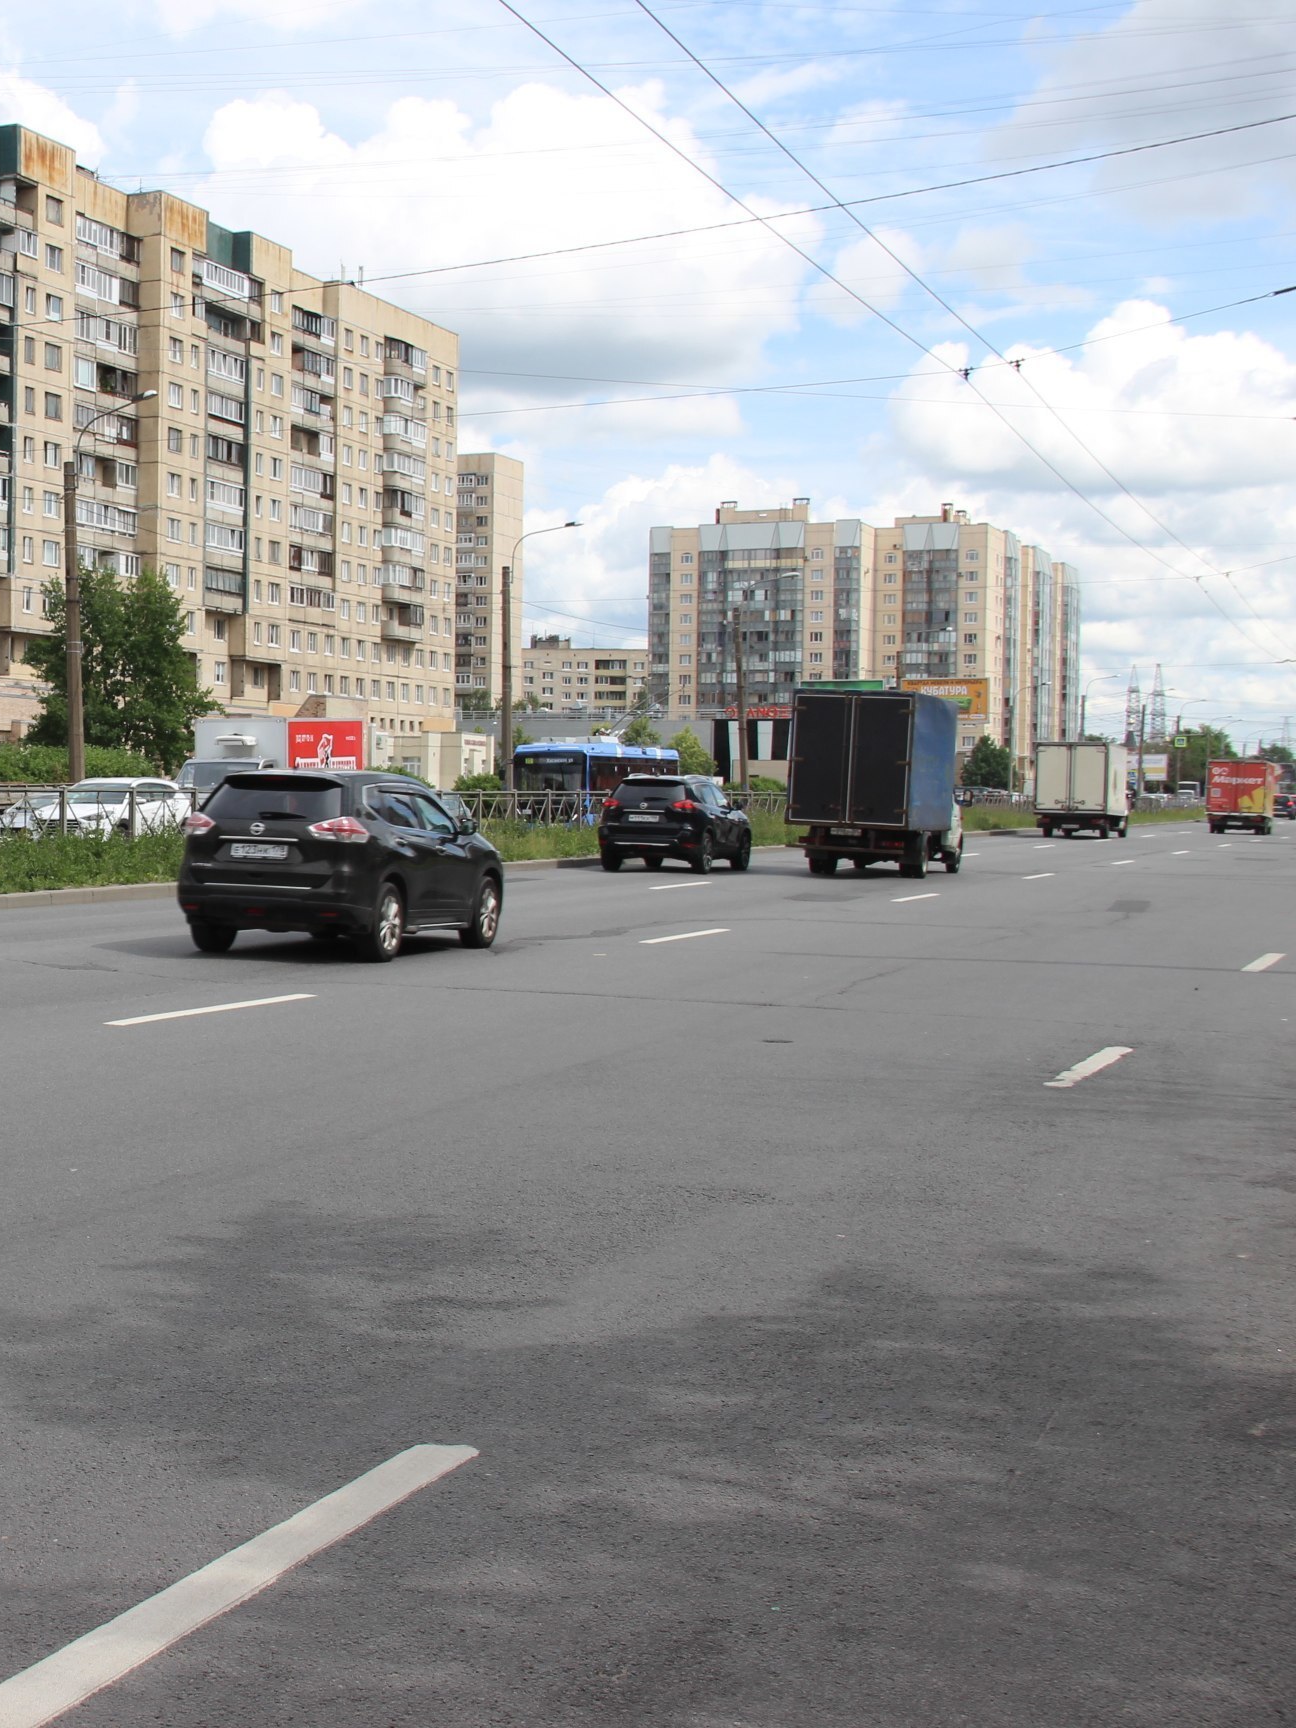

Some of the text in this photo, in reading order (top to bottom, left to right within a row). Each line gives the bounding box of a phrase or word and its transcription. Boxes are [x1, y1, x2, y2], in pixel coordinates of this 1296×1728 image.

[920, 685, 968, 696] КУБАТУРА
[724, 705, 790, 719] OANGE
[1212, 775, 1264, 785] Маркет
